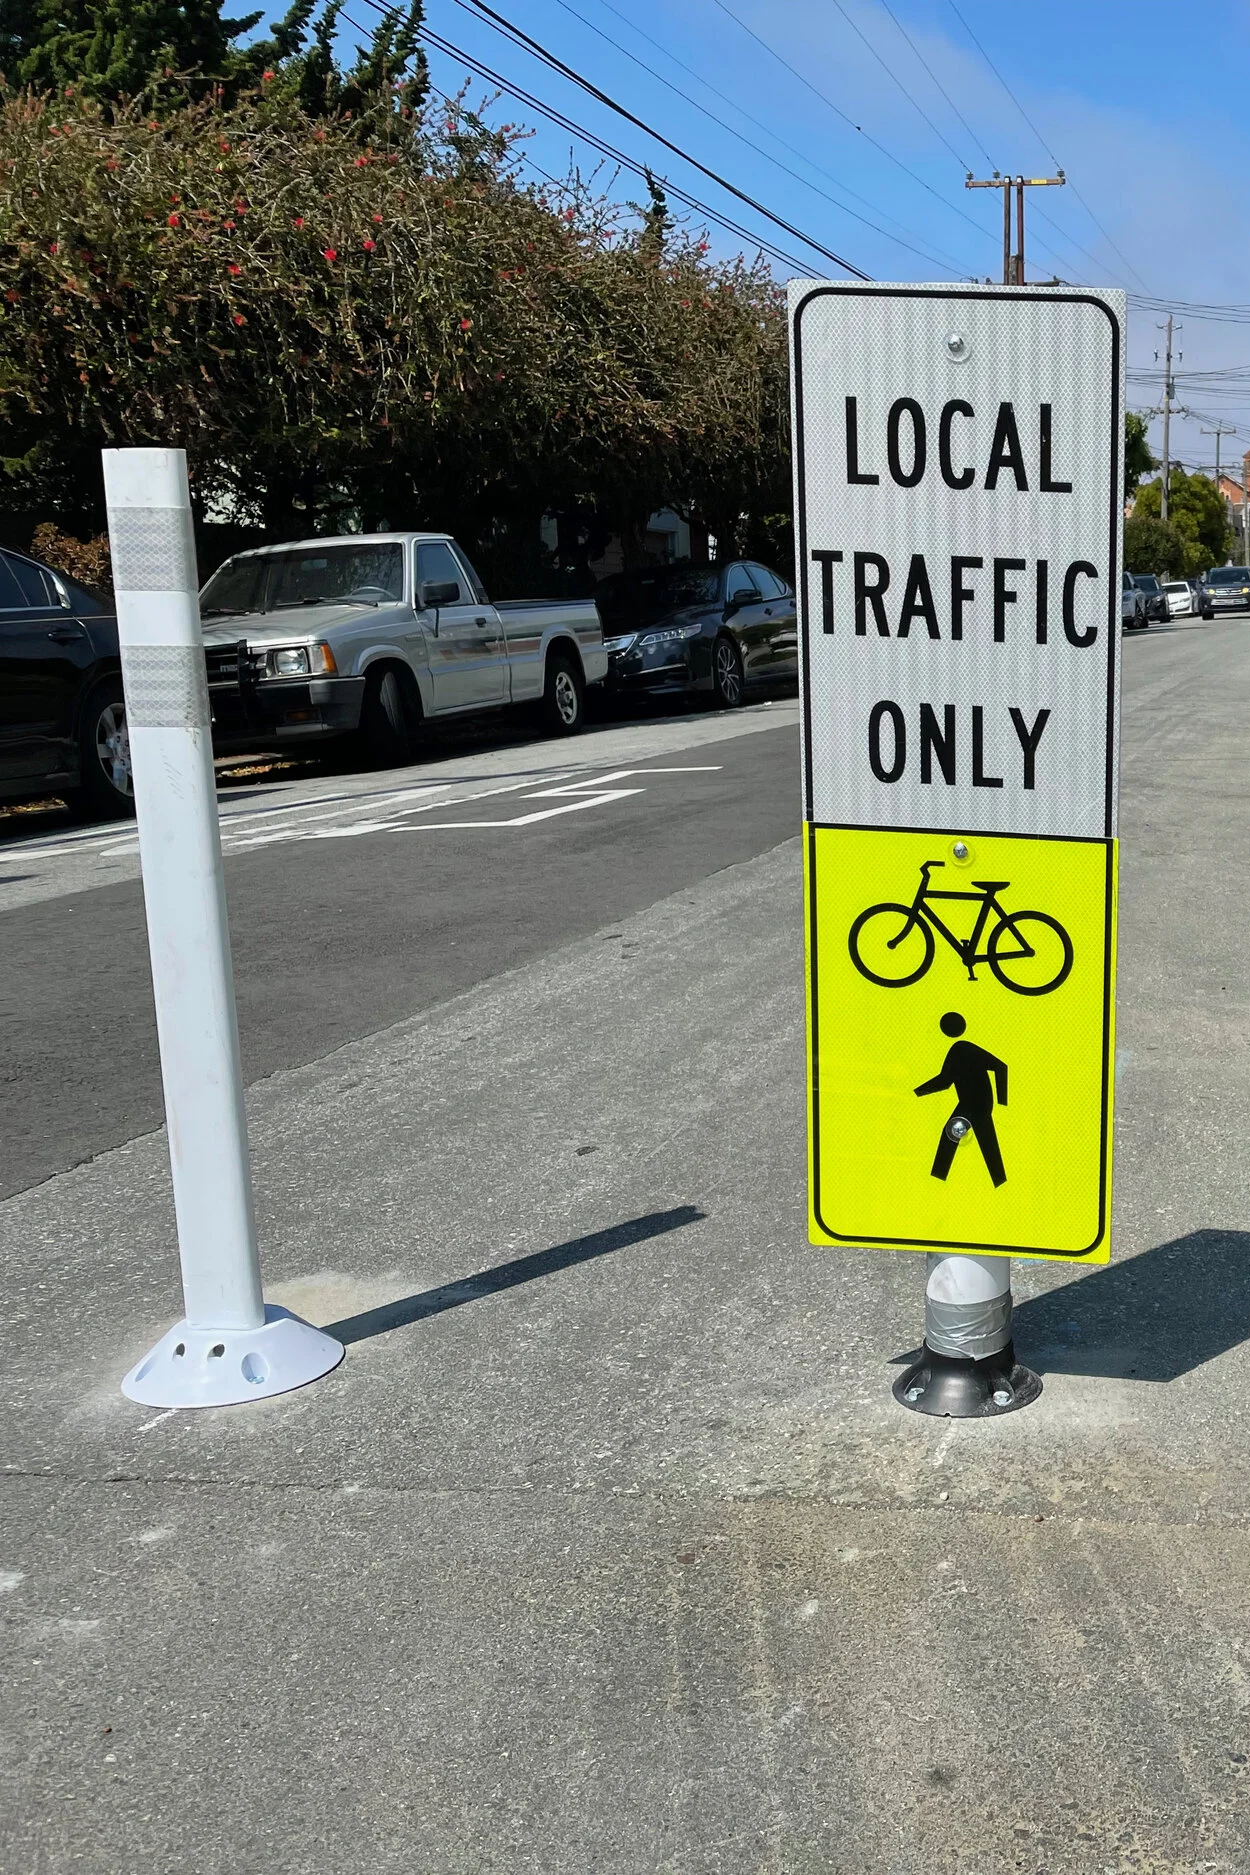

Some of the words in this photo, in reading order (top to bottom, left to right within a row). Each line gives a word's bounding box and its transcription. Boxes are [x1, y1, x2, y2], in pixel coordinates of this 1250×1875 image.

[845, 396, 1073, 493] LOCAL
[811, 549, 1099, 648] TRAFFIC
[868, 700, 1052, 790] ONLY
